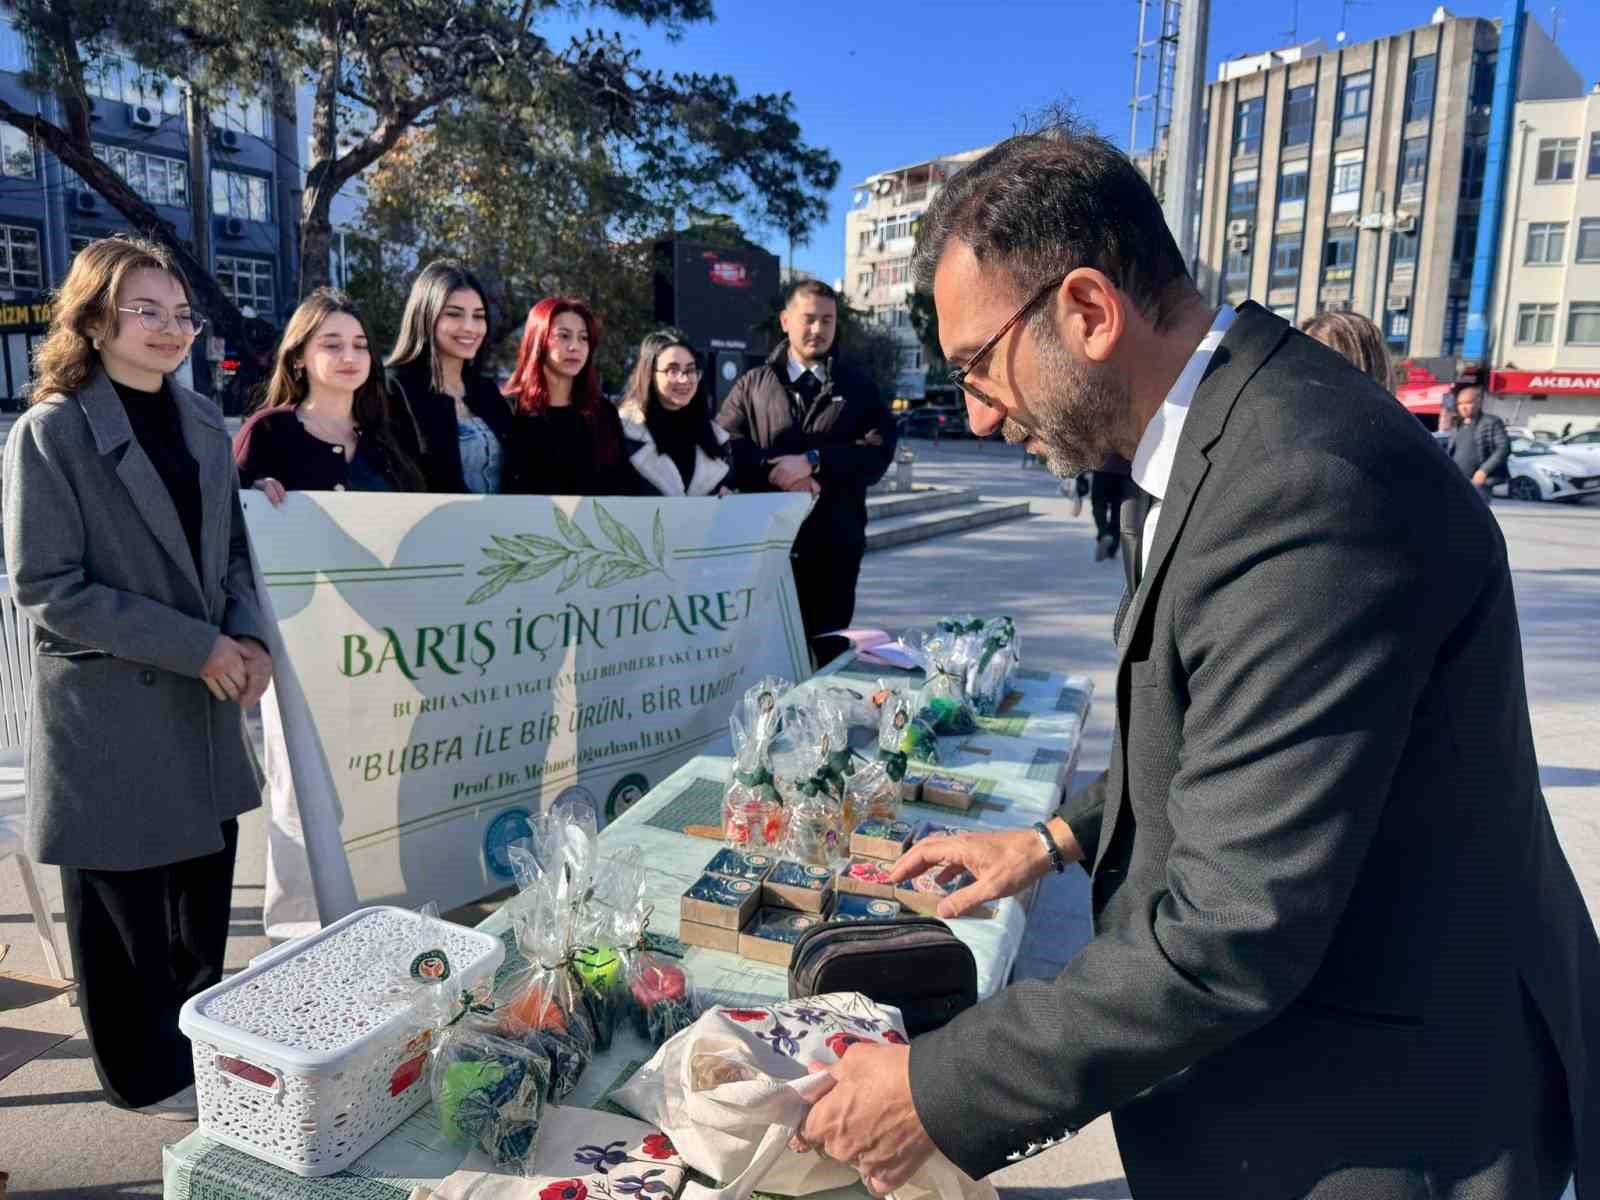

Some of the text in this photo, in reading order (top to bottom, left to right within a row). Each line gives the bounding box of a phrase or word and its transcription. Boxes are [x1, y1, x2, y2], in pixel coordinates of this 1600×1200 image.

[0, 303, 29, 325] İZM
[337, 587, 756, 680] BARIŞ İÇİN TİCARET
[475, 724, 512, 756] İLE
[520, 712, 560, 745] BİR
[568, 695, 632, 732] ÜRÜN,
[641, 685, 683, 714] BİR
[453, 775, 493, 798] Prof.
[499, 771, 520, 789] Dr.
